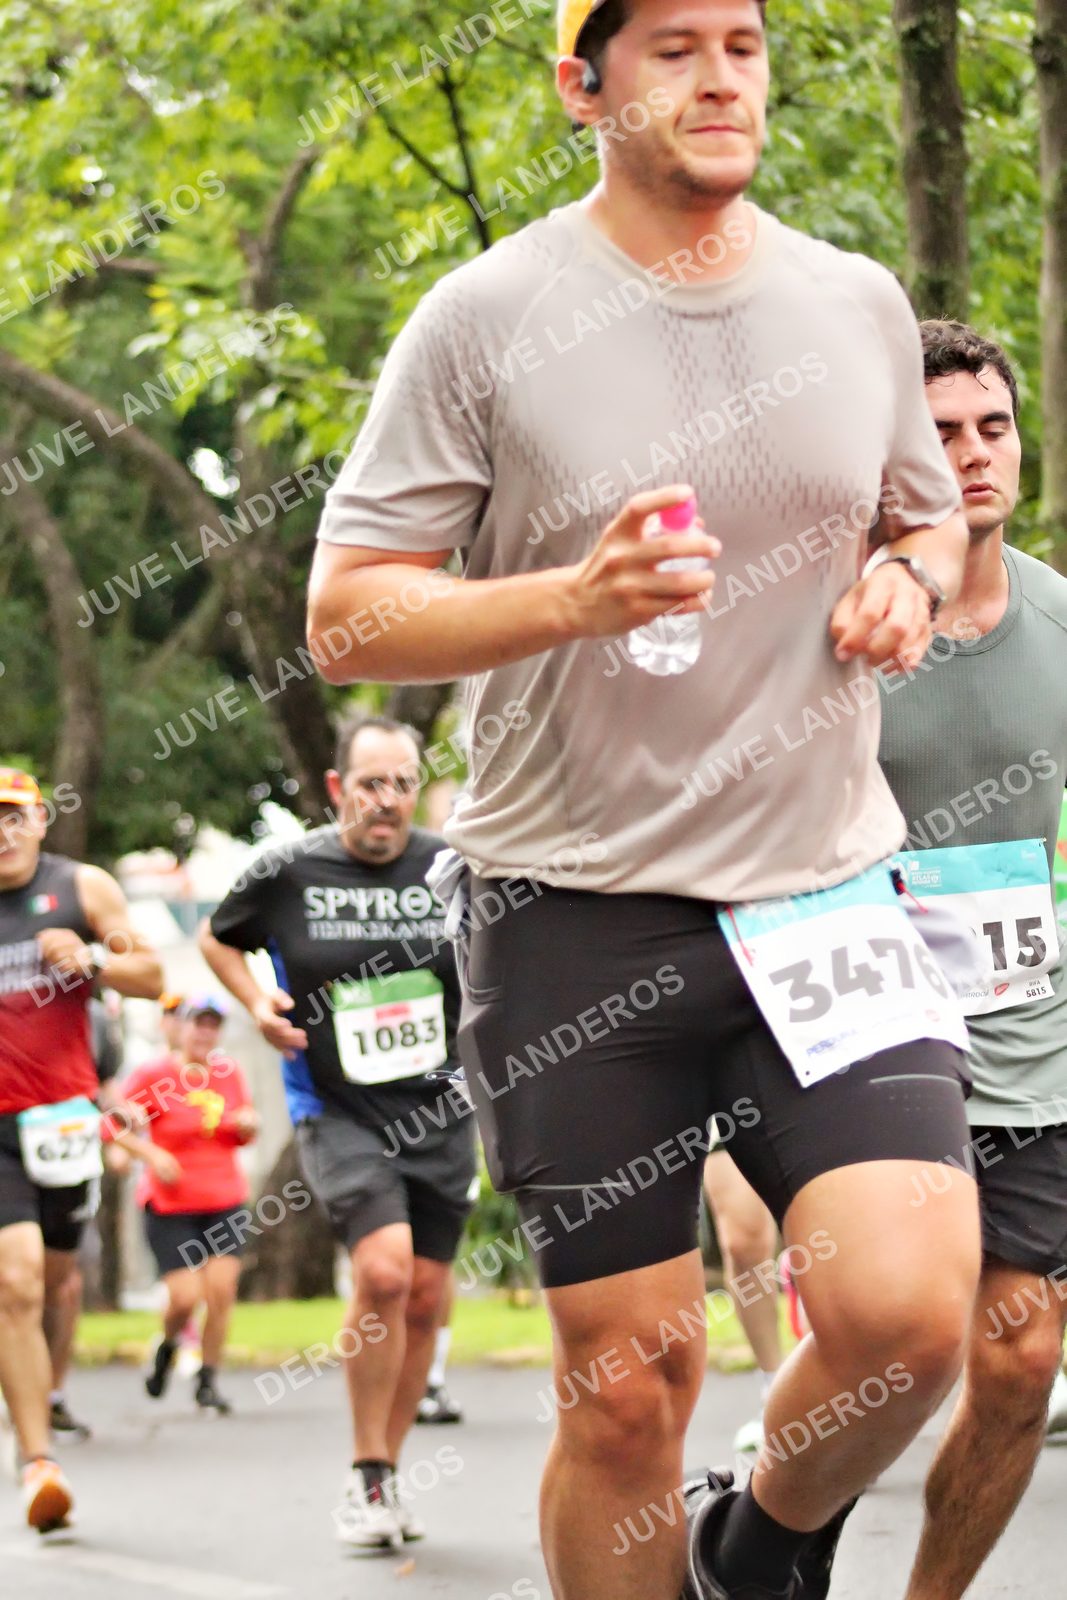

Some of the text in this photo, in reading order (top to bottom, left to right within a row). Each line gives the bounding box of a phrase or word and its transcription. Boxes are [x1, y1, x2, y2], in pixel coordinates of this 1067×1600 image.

[768, 938, 949, 1023] 3476
[1026, 987, 1047, 998] 5815
[353, 1017, 438, 1056] 1083
